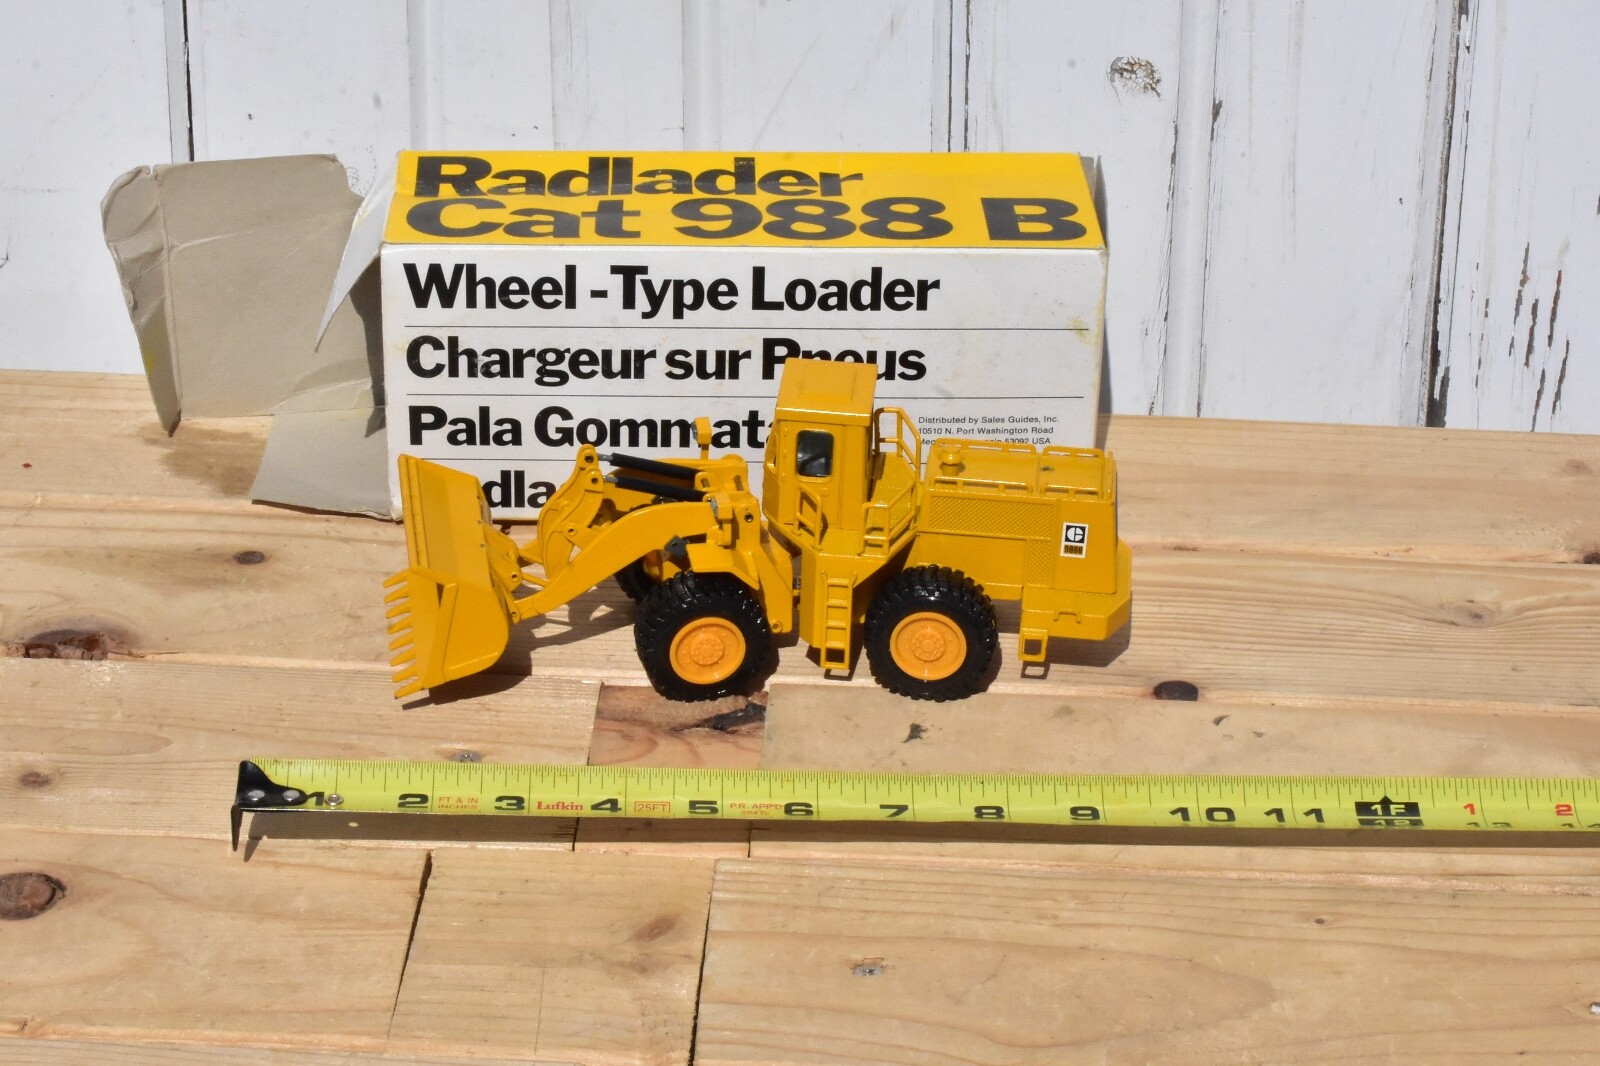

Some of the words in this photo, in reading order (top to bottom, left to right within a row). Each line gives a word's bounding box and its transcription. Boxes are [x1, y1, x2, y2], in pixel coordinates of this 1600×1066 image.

[414, 156, 863, 197] Radlader
[406, 198, 641, 239] Cat
[671, 197, 953, 241] 988
[980, 197, 1087, 241] B
[403, 263, 577, 310] Wheel
[752, 266, 940, 311] Loader
[406, 335, 657, 387] Chargeur
[664, 349, 752, 380] sur
[762, 338, 927, 381] Pus
[408, 405, 523, 446] Pala
[534, 405, 775, 449] Gommat
[918, 416, 966, 424] Distributed
[968, 416, 979, 426] by
[981, 416, 1005, 424] Sales
[1008, 415, 1041, 425] Guides,
[1043, 415, 1060, 423] Inc.
[918, 427, 943, 435] 10510
[945, 427, 954, 435] N.
[956, 426, 975, 435] Port
[977, 427, 1028, 437] Washington
[1031, 426, 1054, 434] Road
[1032, 436, 1051, 445] USA
[398, 793, 429, 809] 2
[494, 795, 526, 811] 3
[536, 800, 584, 811] Lufkin
[590, 798, 622, 813] 4
[688, 800, 719, 815] 5
[784, 802, 814, 816] 6
[879, 804, 909, 818] 7
[974, 805, 1005, 820] 8
[1069, 806, 1100, 821] 9
[1463, 803, 1476, 816] 1
[1555, 803, 1574, 817] 2
